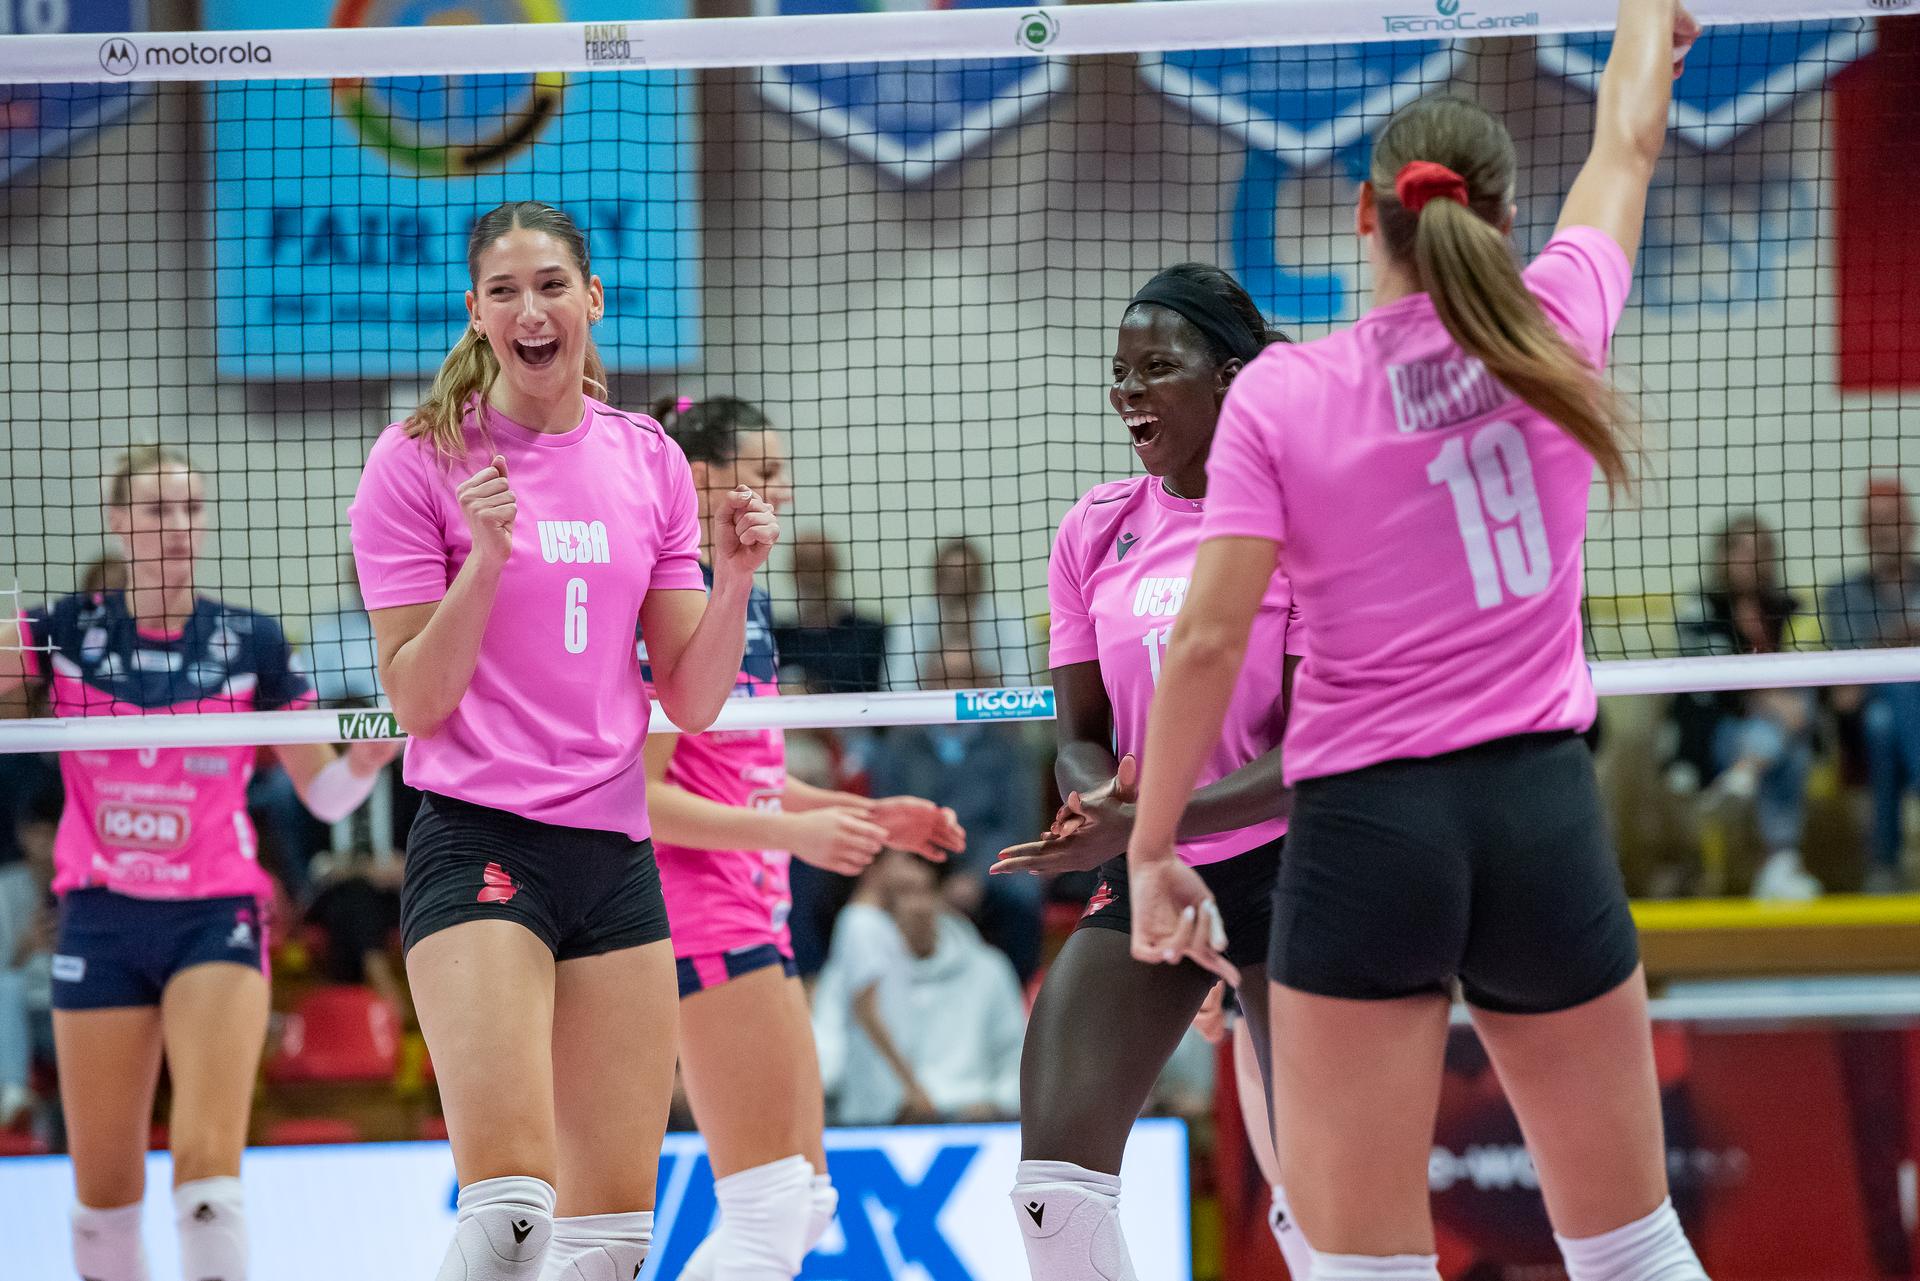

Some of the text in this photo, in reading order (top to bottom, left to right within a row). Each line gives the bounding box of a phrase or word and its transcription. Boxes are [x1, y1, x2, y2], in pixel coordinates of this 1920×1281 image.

[1382, 12, 1539, 33] TecnoCarrelli
[146, 42, 272, 65] motorola
[1427, 421, 1552, 609] 19
[537, 520, 610, 563] UYBA
[564, 577, 588, 654] 6
[1132, 576, 1189, 617] UYB
[1142, 626, 1174, 689] 1
